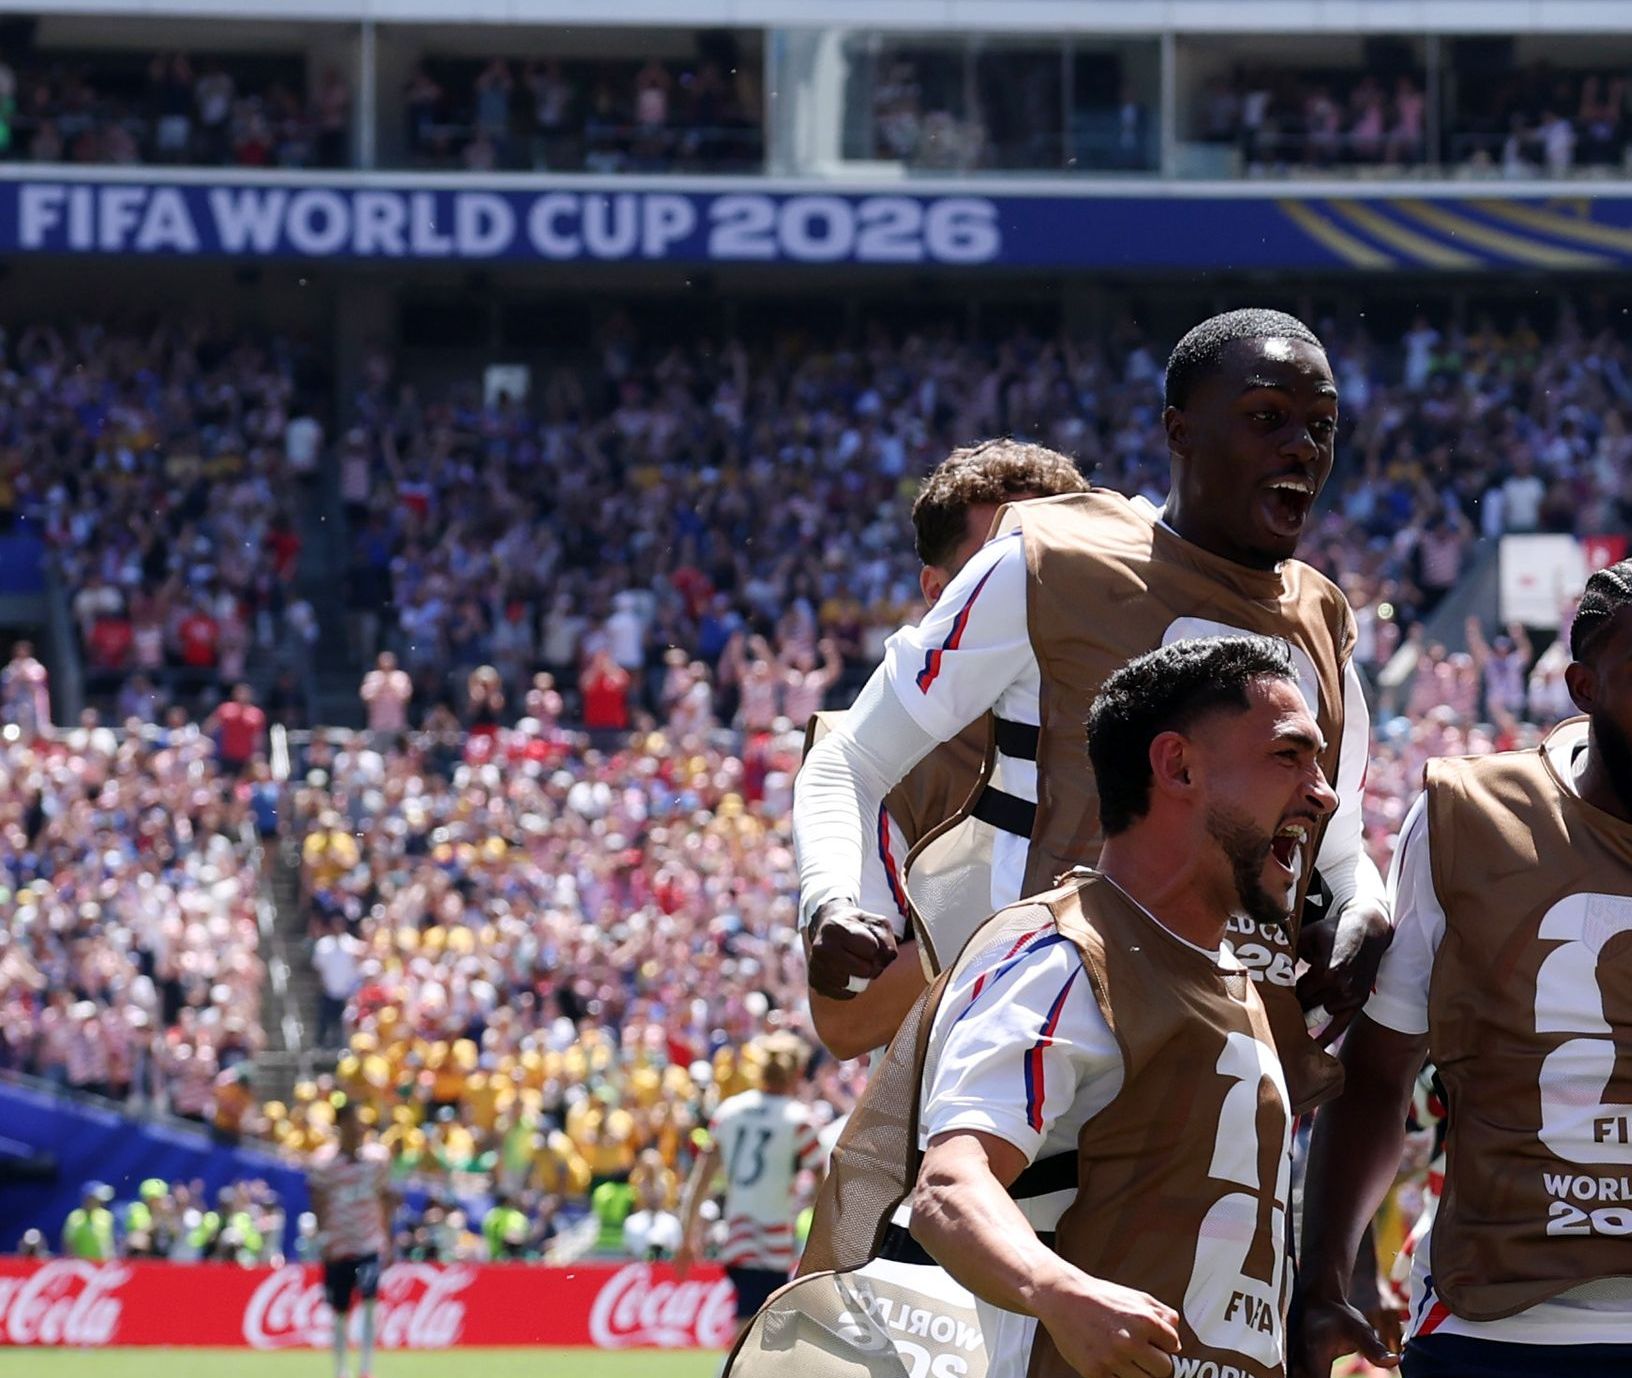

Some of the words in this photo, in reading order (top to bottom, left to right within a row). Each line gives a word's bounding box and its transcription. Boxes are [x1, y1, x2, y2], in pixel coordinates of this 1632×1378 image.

[18, 183, 199, 251] FIFA
[209, 188, 515, 257] WORLD
[529, 192, 696, 259] CUP
[708, 195, 1002, 263] 2026
[730, 1125, 774, 1186] 13
